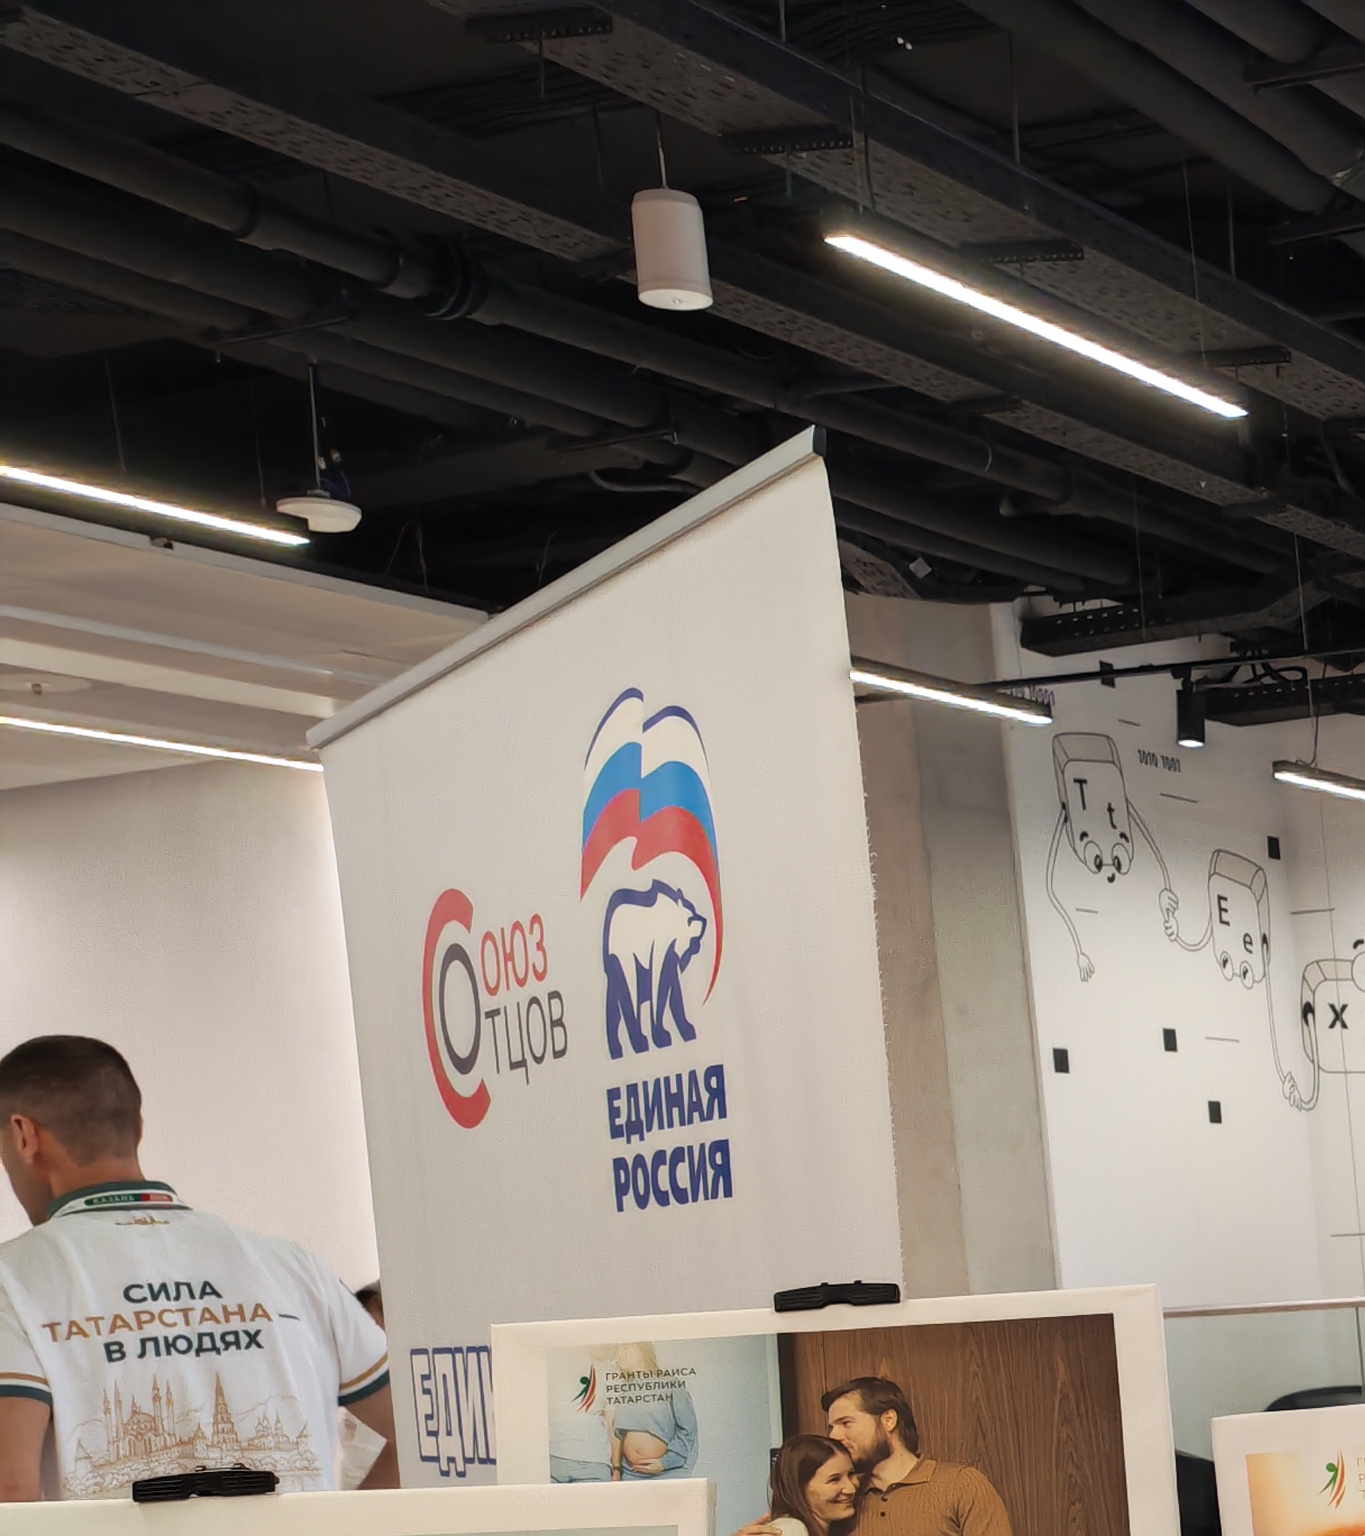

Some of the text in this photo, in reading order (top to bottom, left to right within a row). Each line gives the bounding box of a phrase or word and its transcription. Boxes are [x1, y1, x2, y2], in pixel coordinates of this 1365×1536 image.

[606, 1064, 728, 1144] ЕДИНАЯ
[612, 1138, 734, 1213] РОССИЯ
[123, 1280, 223, 1304] СИЛА
[42, 1303, 273, 1343] ТАТАРСТАНА
[104, 1329, 264, 1363] В ЛЮДЯХ
[605, 1367, 697, 1381] ГРАНТЫ РАИСА
[606, 1380, 686, 1393] РЕСПУБЛИКИ
[607, 1393, 674, 1405] ТАТАРСТАН
